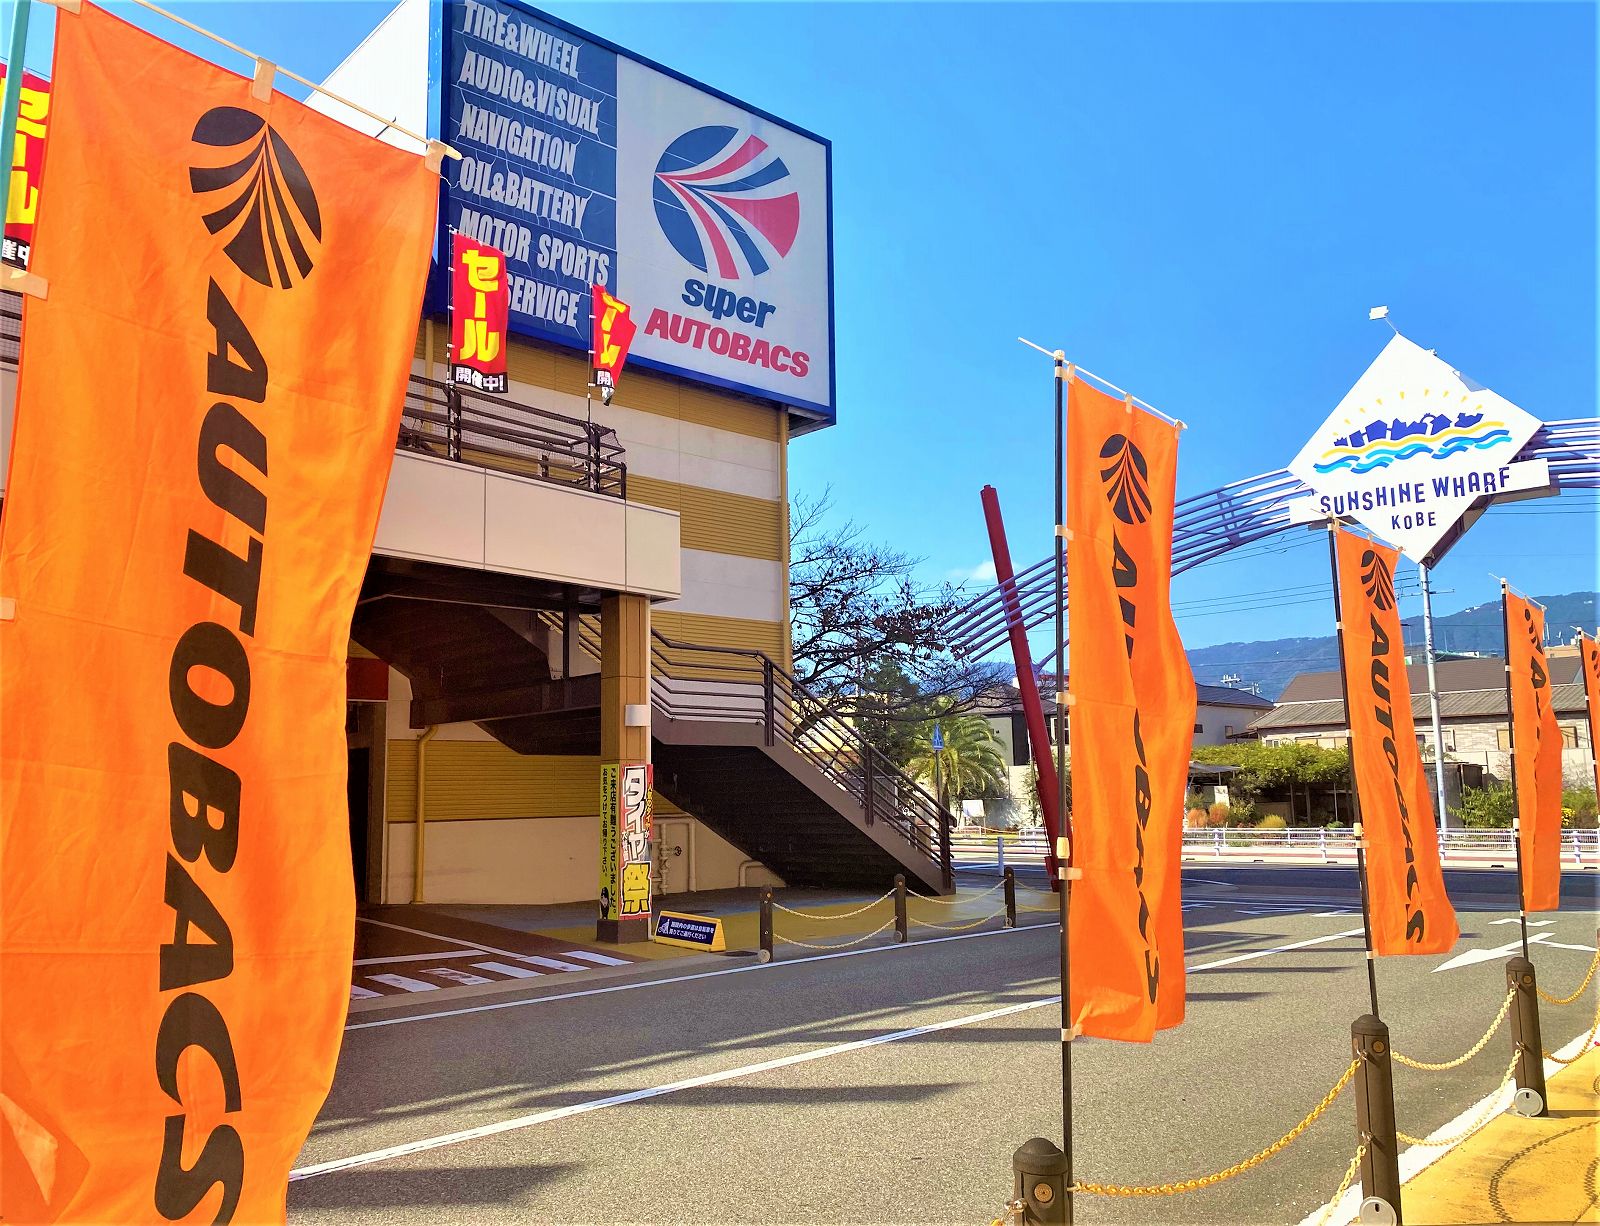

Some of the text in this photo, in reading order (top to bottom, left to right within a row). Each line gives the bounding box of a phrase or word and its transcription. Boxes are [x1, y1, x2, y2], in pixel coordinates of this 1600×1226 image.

[462, 0, 581, 78] TIRE&WHEEL
[458, 50, 603, 135] AUDIO&VISUAL
[457, 102, 578, 177] NAVIGATION
[459, 155, 588, 230] OIL&BATTERY
[458, 207, 610, 287] MOTOR SPORTS
[461, 249, 500, 362] セール
[682, 278, 777, 329] super
[455, 366, 504, 392] 開催中!
[643, 307, 811, 378] AUTOBACS
[1320, 466, 1510, 516] SUNSHINE WHARF
[1391, 511, 1437, 530] KOBE
[154, 275, 268, 1226] AUTOBACS
